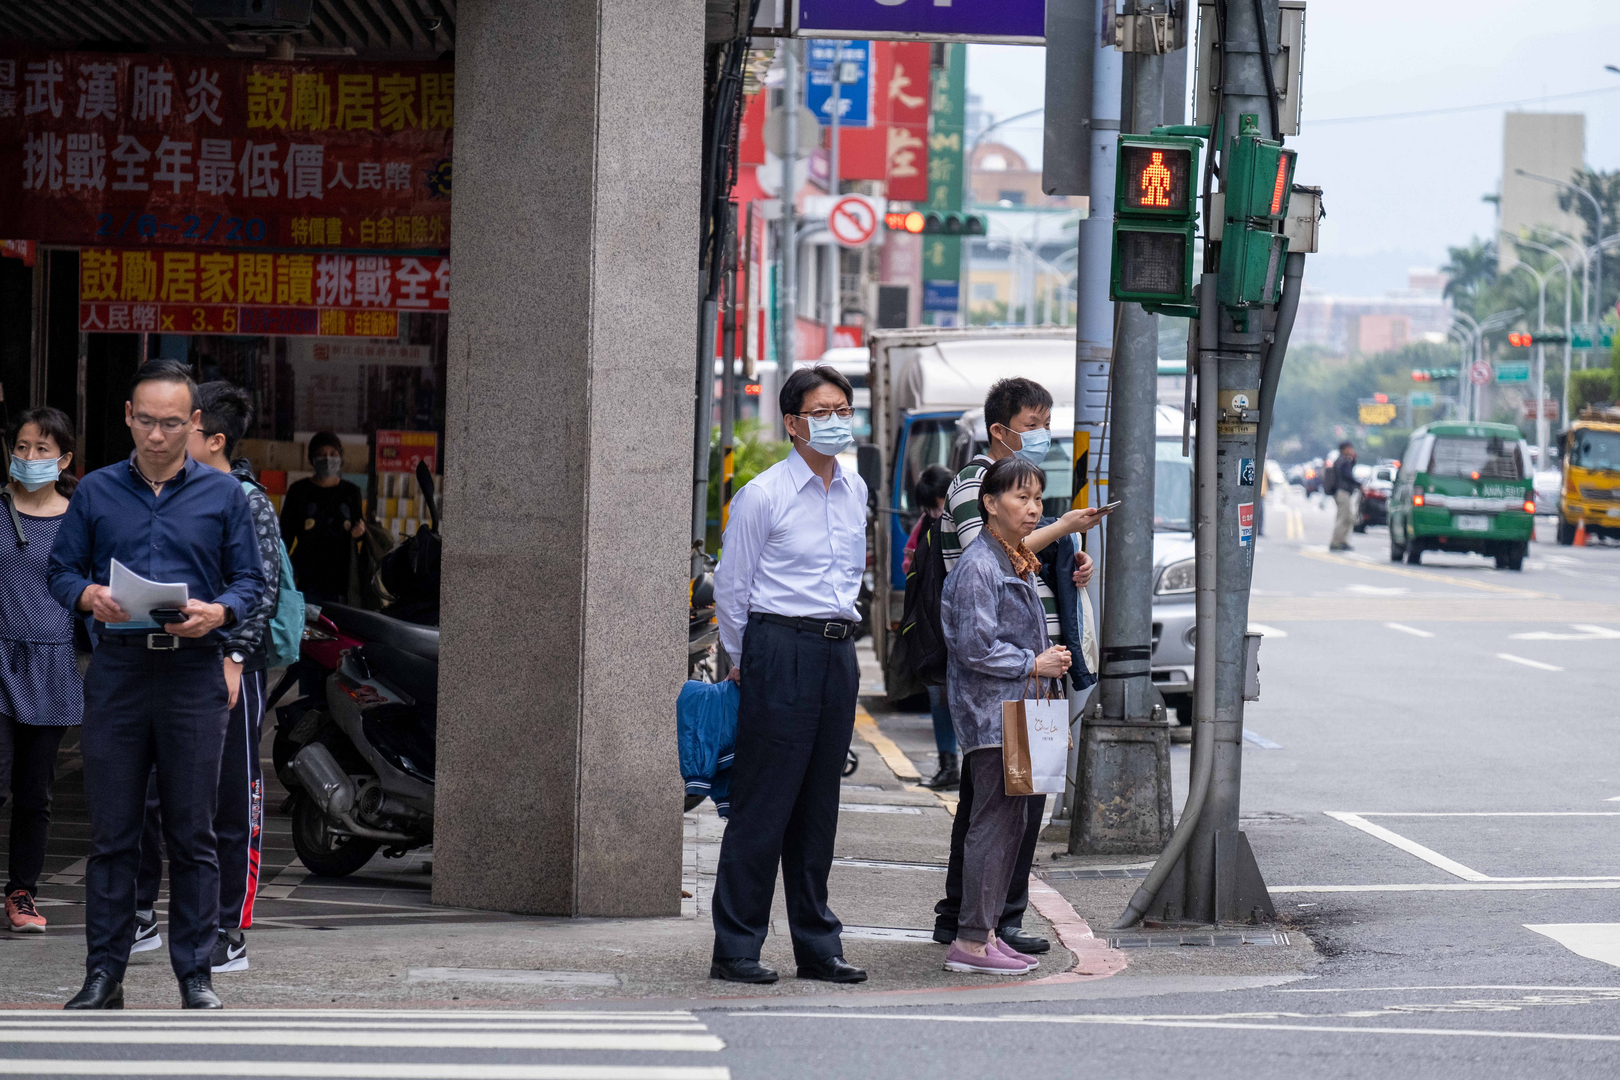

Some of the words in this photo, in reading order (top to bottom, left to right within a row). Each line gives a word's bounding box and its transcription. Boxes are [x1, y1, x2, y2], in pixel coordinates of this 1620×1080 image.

[23, 59, 223, 126] 武漢肺炎
[246, 71, 454, 132] 鼓勵居家閱
[22, 132, 325, 199] 挑戰全年最低價
[327, 162, 412, 191] 人民幣
[81, 249, 314, 306] 鼓勵居家閱讀
[82, 305, 158, 330] 人民幣
